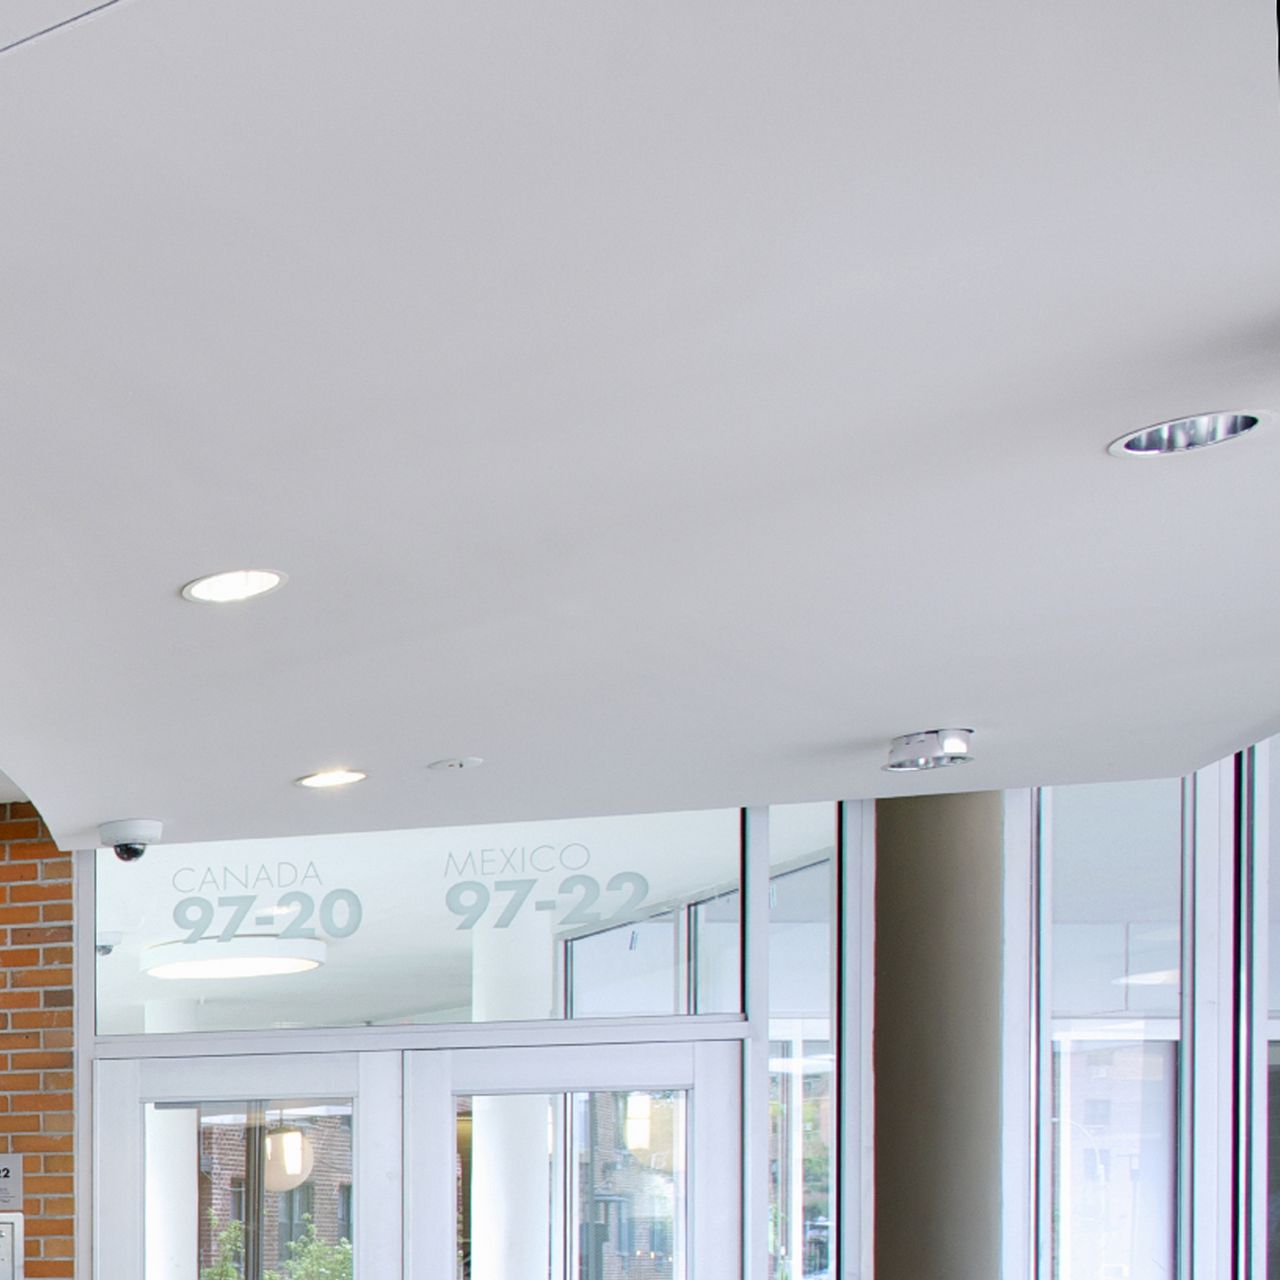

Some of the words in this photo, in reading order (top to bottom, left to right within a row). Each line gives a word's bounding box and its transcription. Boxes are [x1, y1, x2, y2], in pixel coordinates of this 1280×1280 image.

[171, 860, 323, 893] CANADA
[443, 842, 591, 878] MEXICO
[172, 887, 363, 944] 97-20
[445, 871, 650, 931] 97-22
